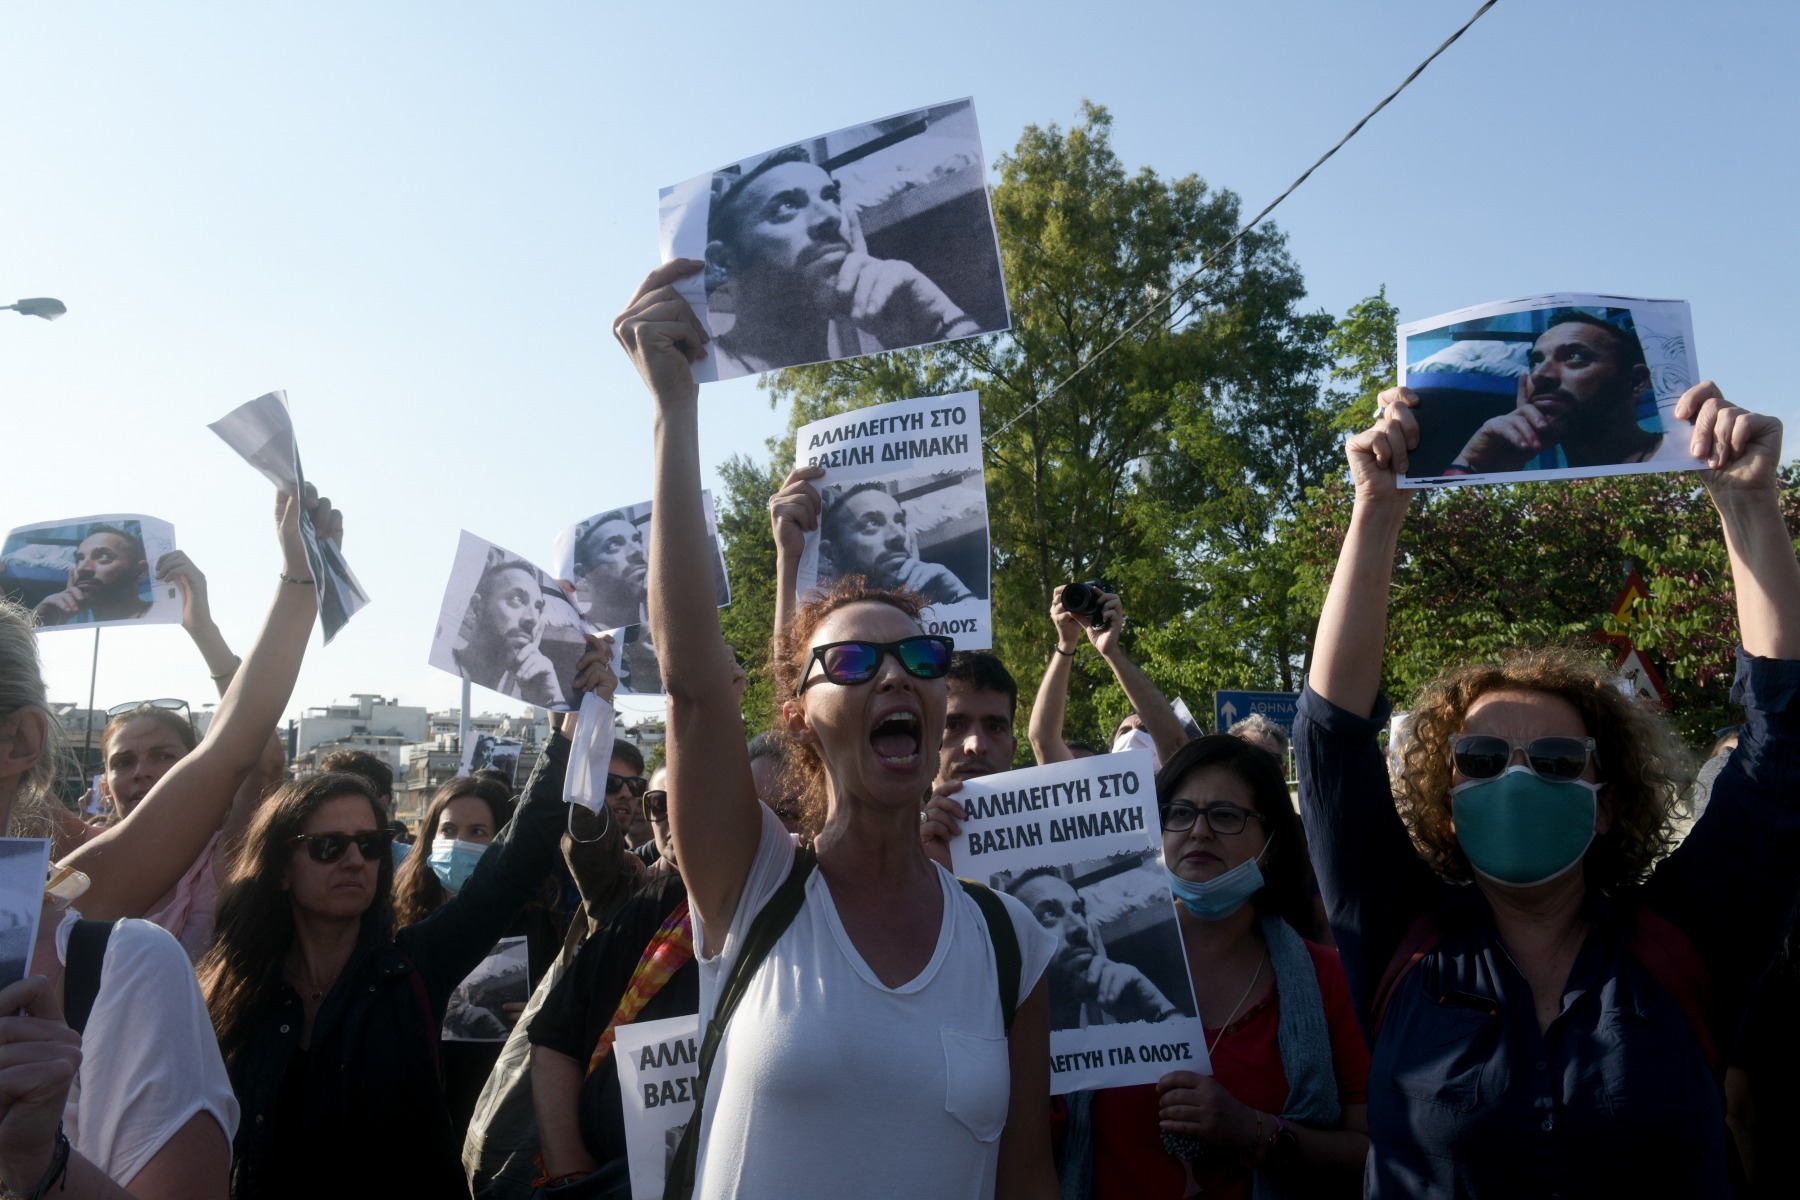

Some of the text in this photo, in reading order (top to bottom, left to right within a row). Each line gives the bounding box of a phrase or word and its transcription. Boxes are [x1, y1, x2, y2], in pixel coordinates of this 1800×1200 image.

[809, 406, 967, 451] ΑΛΛΗΛΕΓΓΥΗ ΣΤΟ
[808, 434, 969, 469] ΒΑΣΙΛΗ ΔΗΜΑΚΗ
[928, 618, 978, 635] ΟΛΟΥΣ
[1249, 702, 1295, 714] ΑΘΗΝΑ
[963, 771, 1140, 822] ΑΛΛΗΛΕΓΓΥΗ ΣΤΟ
[968, 806, 1145, 856] ΒΑΣΙΛΗ ΔΗΜΑΚΗ
[1050, 1042, 1193, 1074] ΛΕΓΓΥΗ ΓΙΑ ΟΛΟΥΣ
[643, 1076, 697, 1109] ΒΑΣΙ
